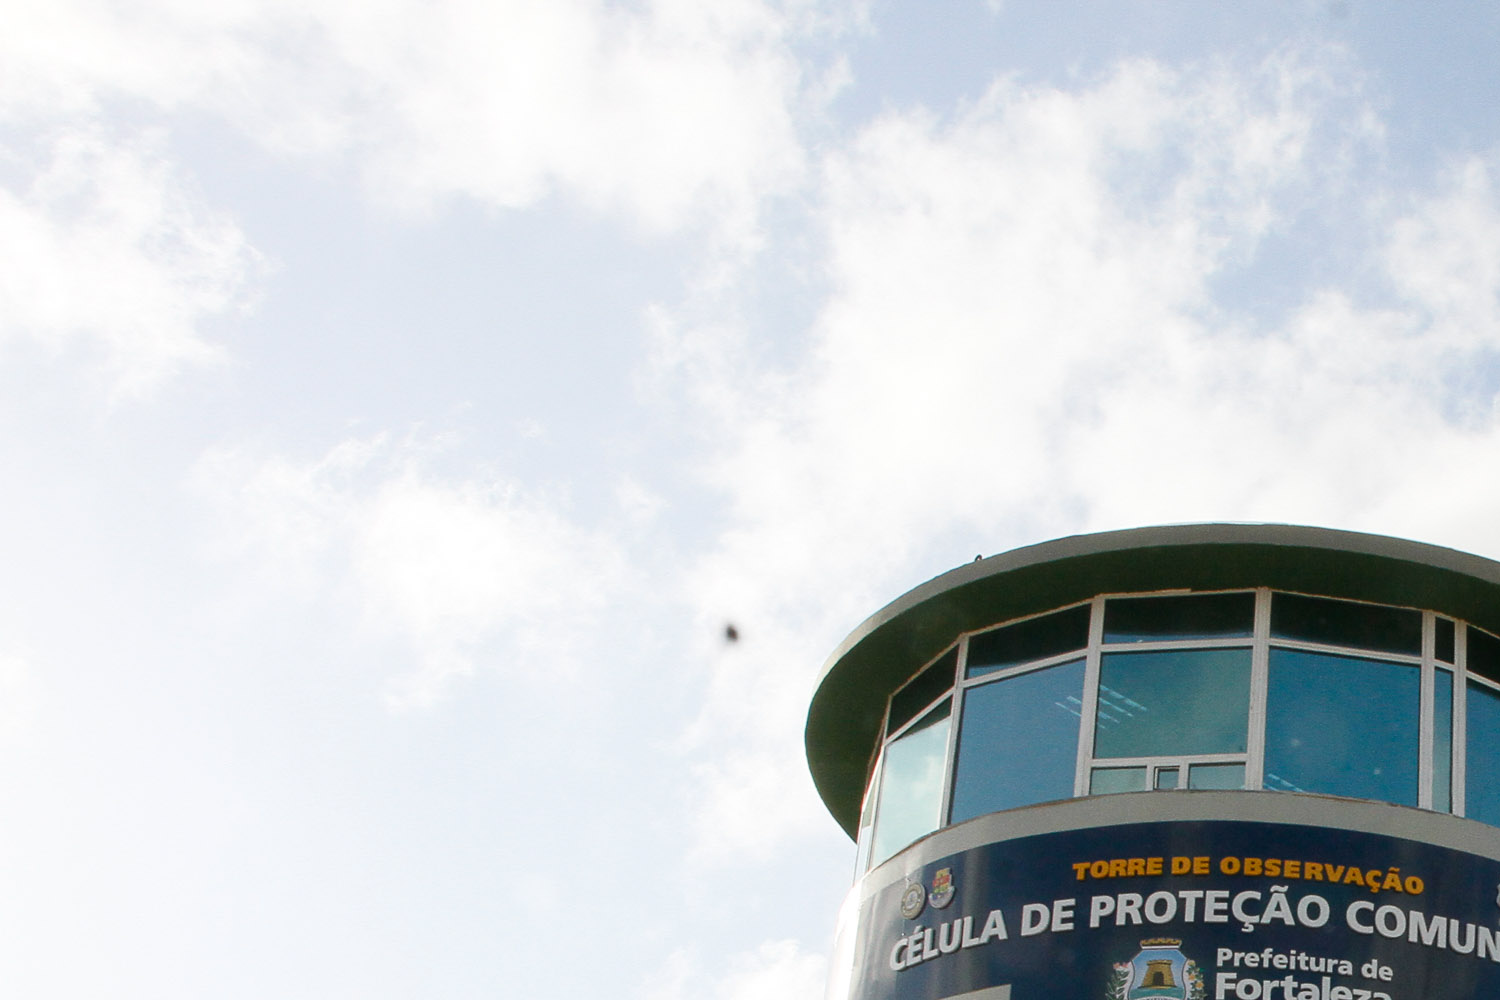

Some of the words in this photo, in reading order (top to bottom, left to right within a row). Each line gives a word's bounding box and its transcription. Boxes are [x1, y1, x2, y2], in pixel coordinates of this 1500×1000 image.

[1073, 857, 1163, 881] TORRE
[1171, 856, 1210, 876] DE
[1220, 856, 1425, 896] OBSERVAÇÃO
[889, 909, 1009, 971] CÉLULA
[1020, 897, 1077, 937] DE
[1089, 885, 1330, 933] PROTEÇÃO
[1216, 947, 1353, 975] Prefeitura
[1361, 959, 1393, 981] de
